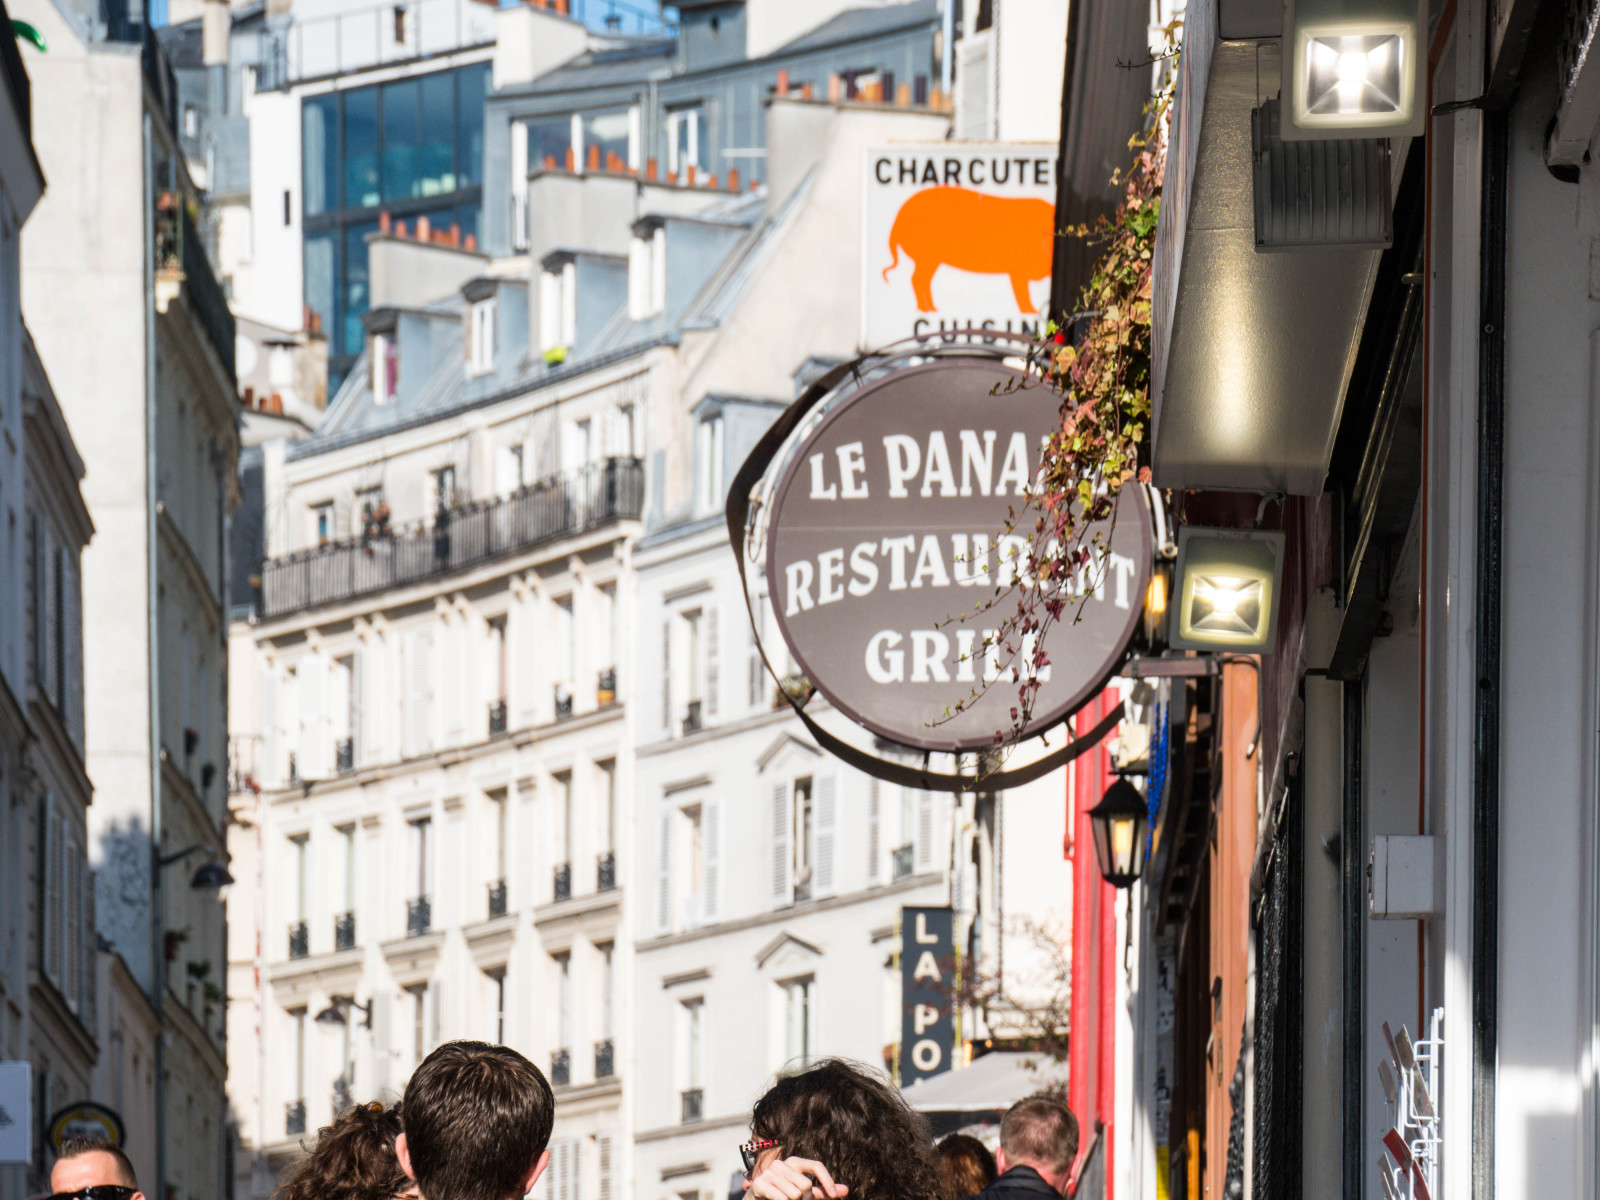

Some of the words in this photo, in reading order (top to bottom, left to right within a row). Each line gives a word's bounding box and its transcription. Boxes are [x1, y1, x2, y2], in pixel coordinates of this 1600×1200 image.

[875, 158, 1059, 185] CHARCUTE
[809, 441, 869, 500] LE
[882, 430, 1109, 498] PANA
[865, 629, 1052, 684] GRILL
